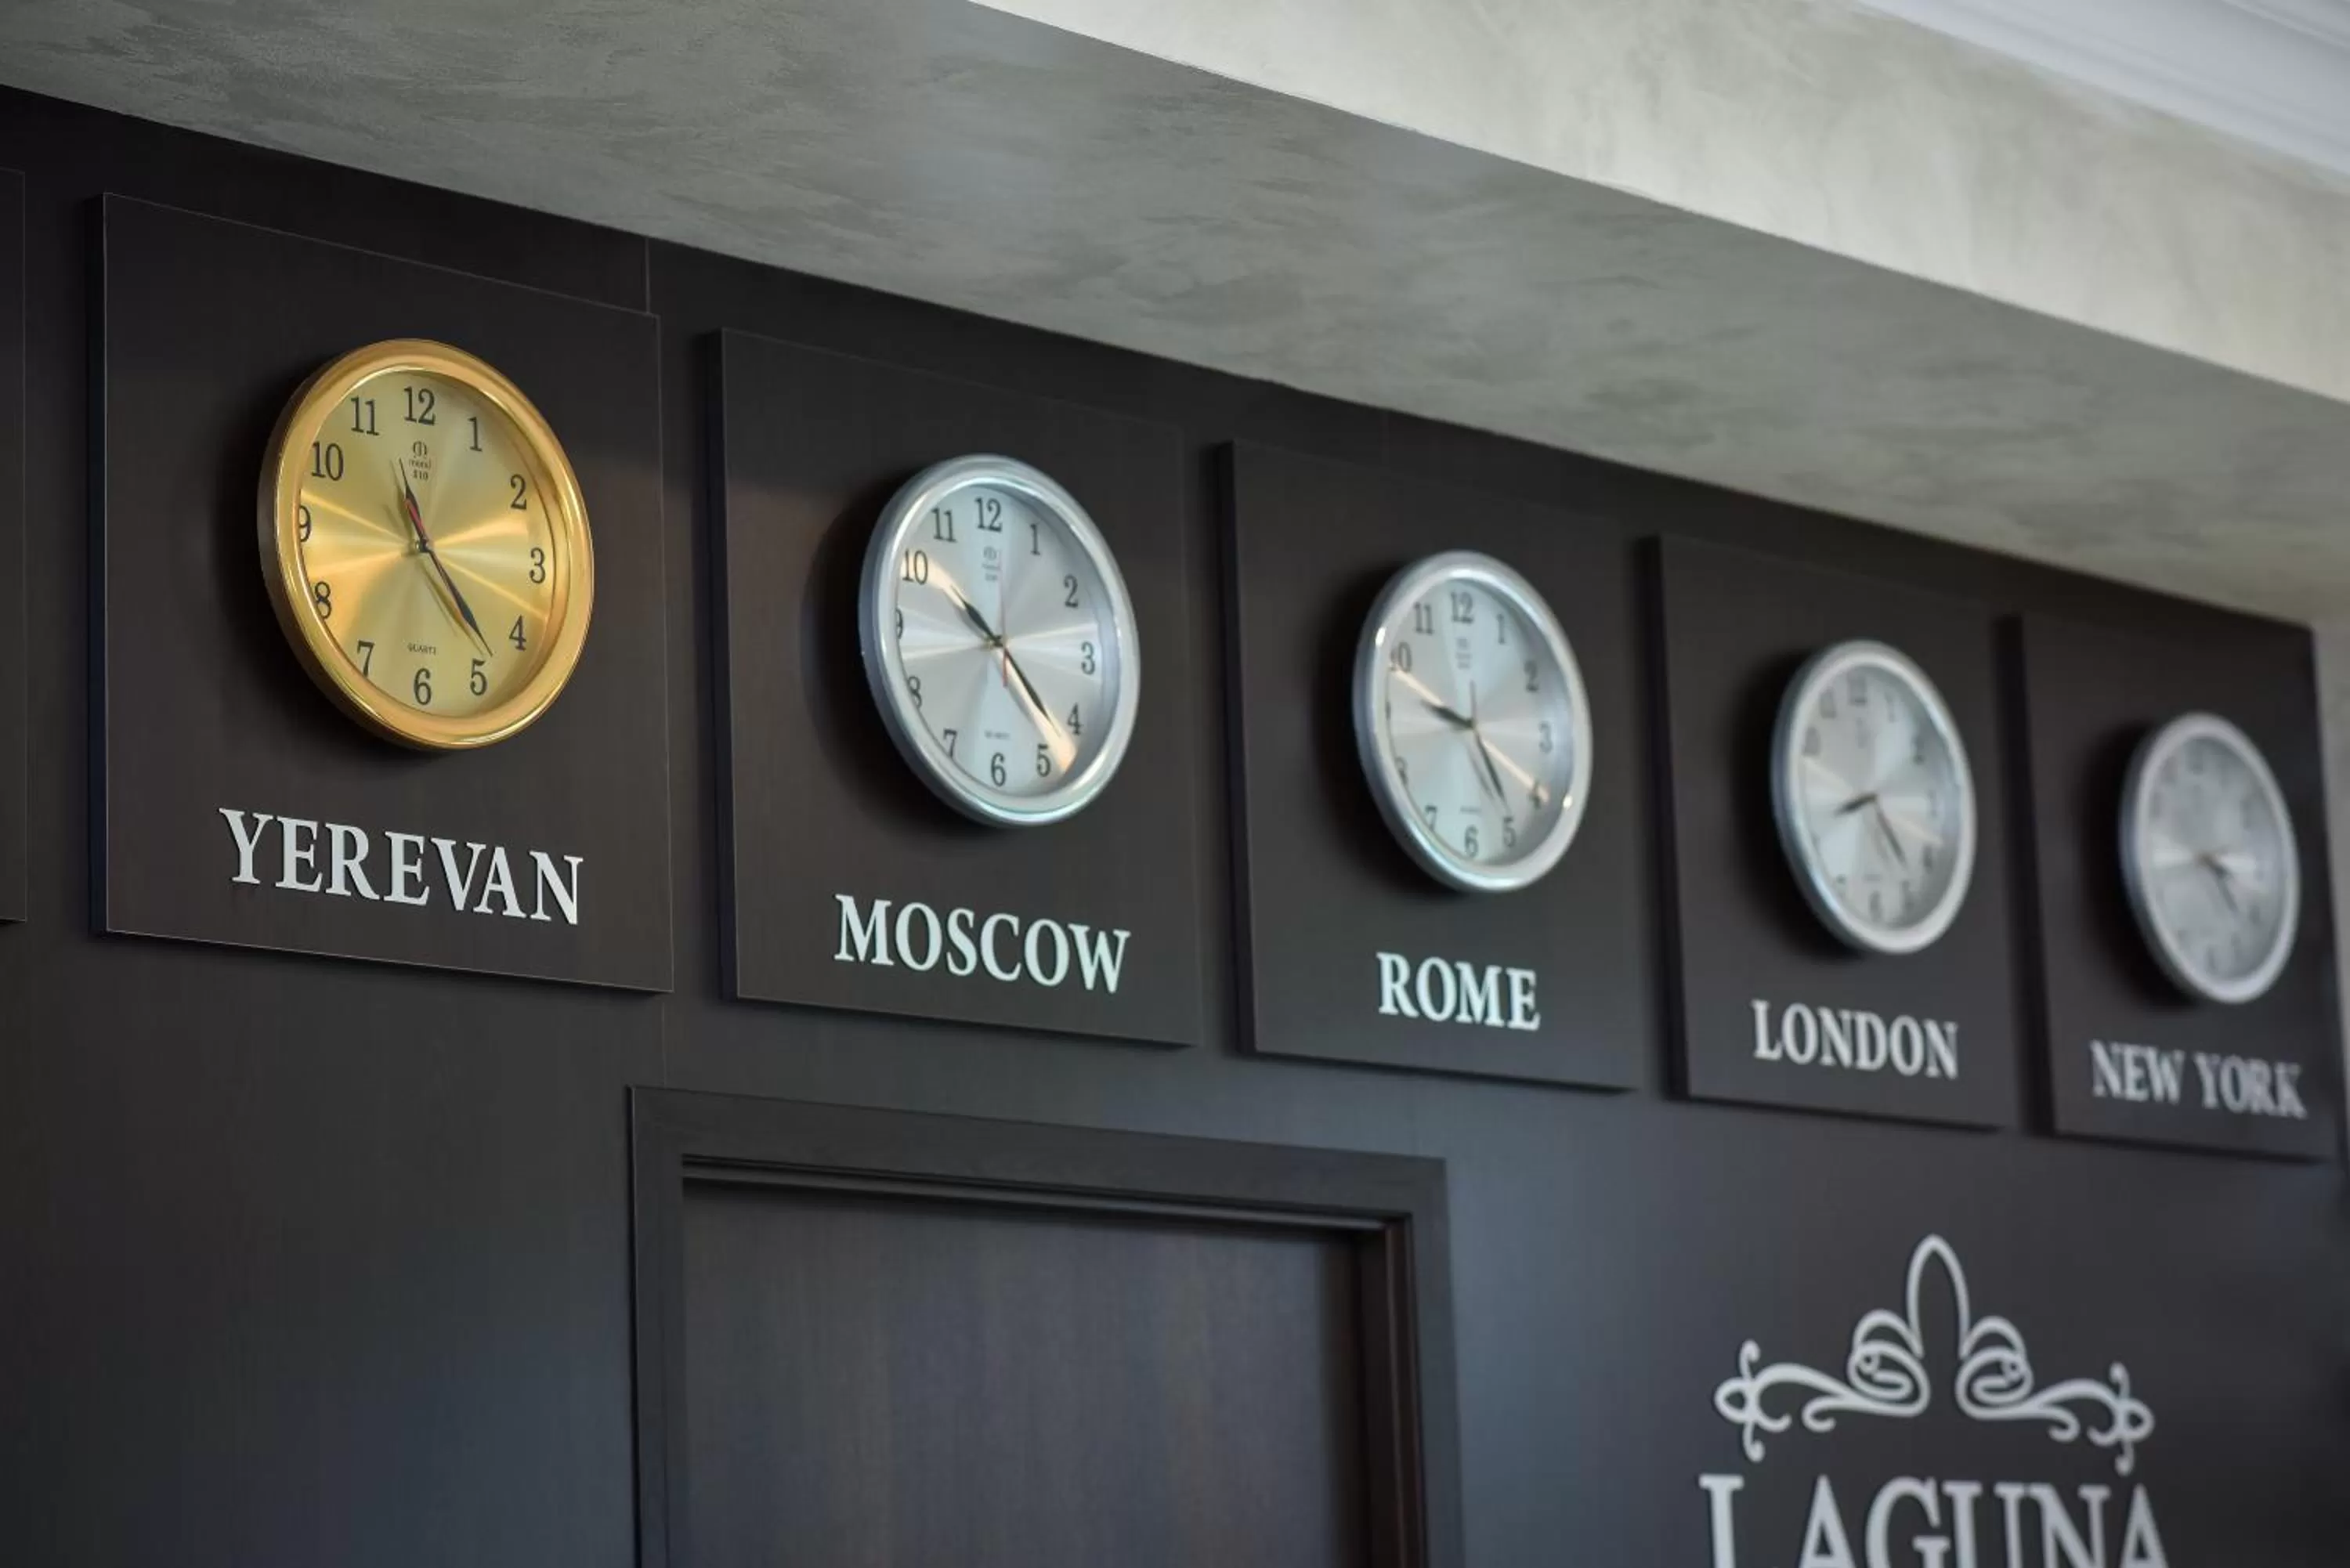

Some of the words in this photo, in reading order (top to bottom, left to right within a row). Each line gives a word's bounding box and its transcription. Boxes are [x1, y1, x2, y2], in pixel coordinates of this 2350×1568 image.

[350, 396, 380, 436] 11
[403, 387, 436, 425] 12
[468, 416, 483, 452] 1
[311, 442, 344, 481] 10
[510, 473, 528, 510] 2
[931, 507, 956, 543] 11
[974, 497, 1002, 533] 12
[1030, 523, 1041, 556] 1
[530, 547, 547, 583] 3
[902, 549, 928, 585] 10
[314, 580, 332, 620] 8
[1064, 575, 1079, 608] 2
[1450, 591, 1473, 624] 12
[509, 615, 527, 651] 4
[1413, 602, 1434, 635] 11
[1496, 613, 1506, 645] 1
[357, 640, 375, 678] 7
[1081, 641, 1096, 675] 3
[1524, 659, 1538, 692] 2
[414, 667, 432, 706] 6
[470, 658, 488, 696] 5
[907, 676, 922, 709] 8
[1068, 703, 1083, 735] 4
[942, 728, 957, 760] 7
[1538, 722, 1553, 753] 3
[991, 752, 1007, 787] 6
[1036, 743, 1051, 777] 5
[1425, 805, 1438, 833] 7
[1502, 817, 1517, 848] 5
[1464, 826, 1478, 858] 6
[219, 807, 584, 925] YEREVAN
[834, 894, 1130, 994] MOSCOW
[1376, 951, 1541, 1031] ROME
[1751, 998, 1959, 1080] LONDON
[2090, 1039, 2186, 1104] NEW
[2193, 1051, 2308, 1120] YORK
